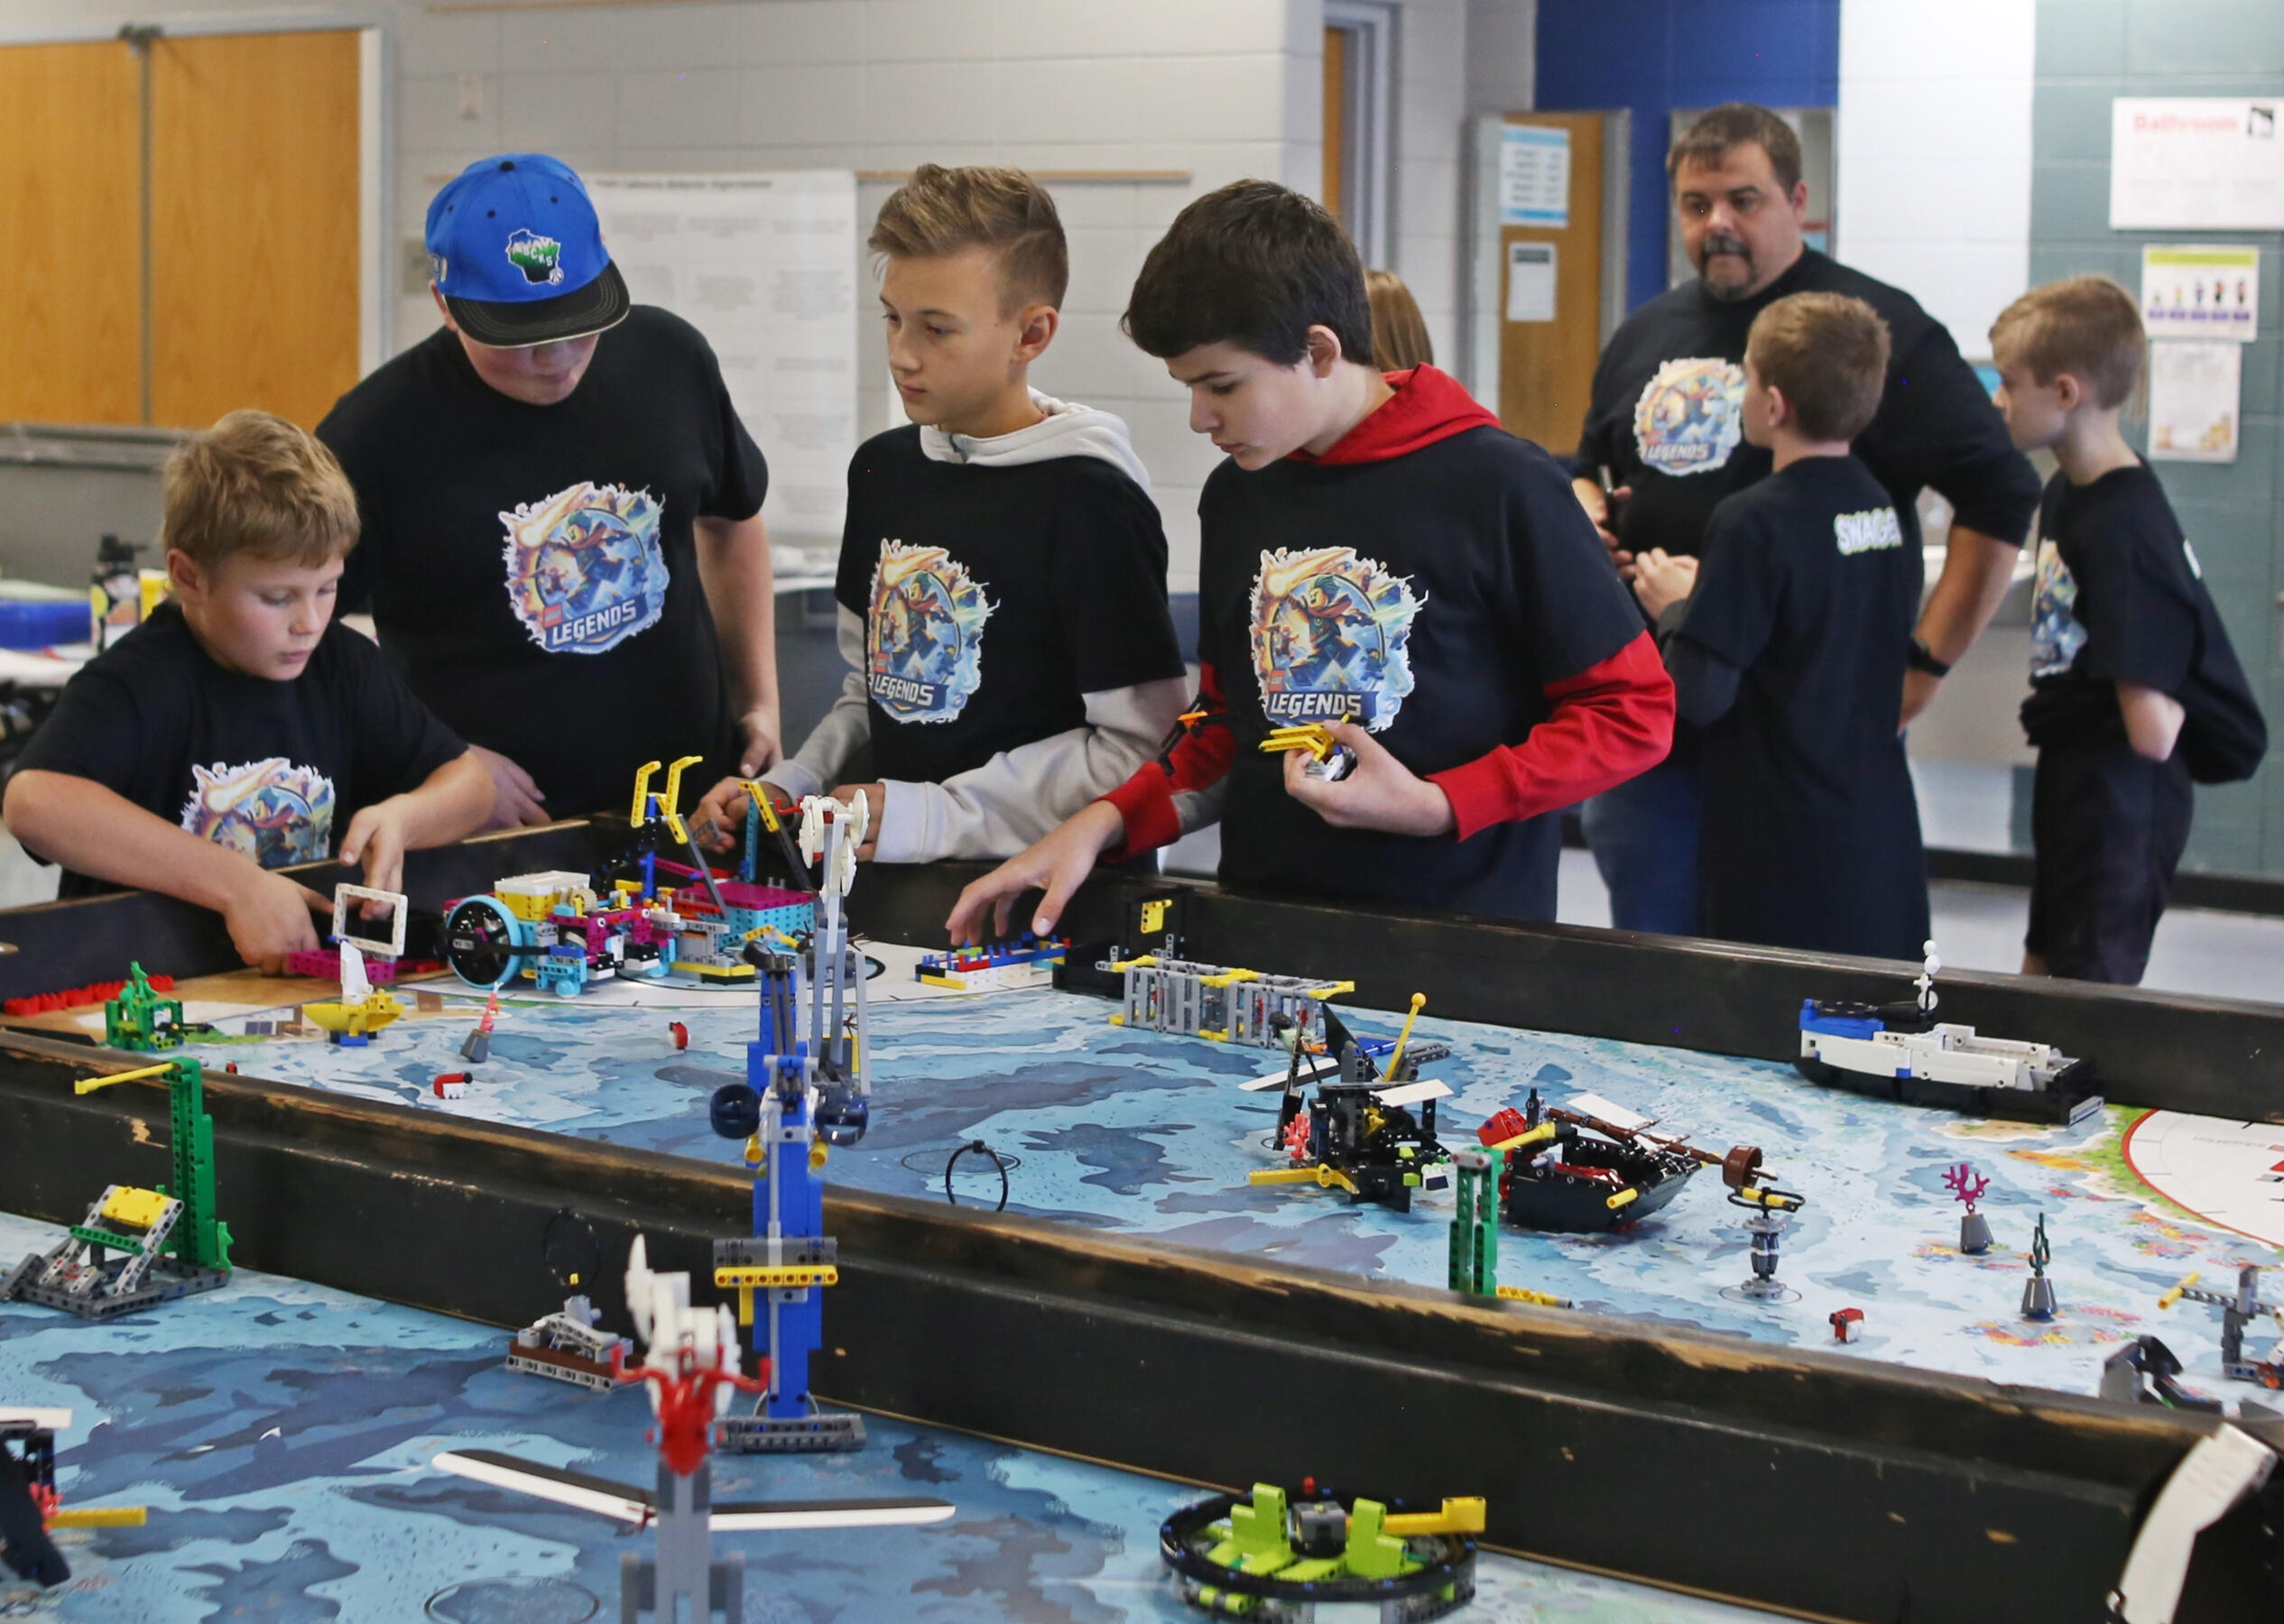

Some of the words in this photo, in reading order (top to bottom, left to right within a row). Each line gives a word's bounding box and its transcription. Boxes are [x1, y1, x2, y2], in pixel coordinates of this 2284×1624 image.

[1647, 444, 1709, 462] LEGENDS
[552, 599, 636, 645] LEGENDS
[874, 674, 935, 706] LEGENDS
[1270, 693, 1362, 718] LEGENDS
